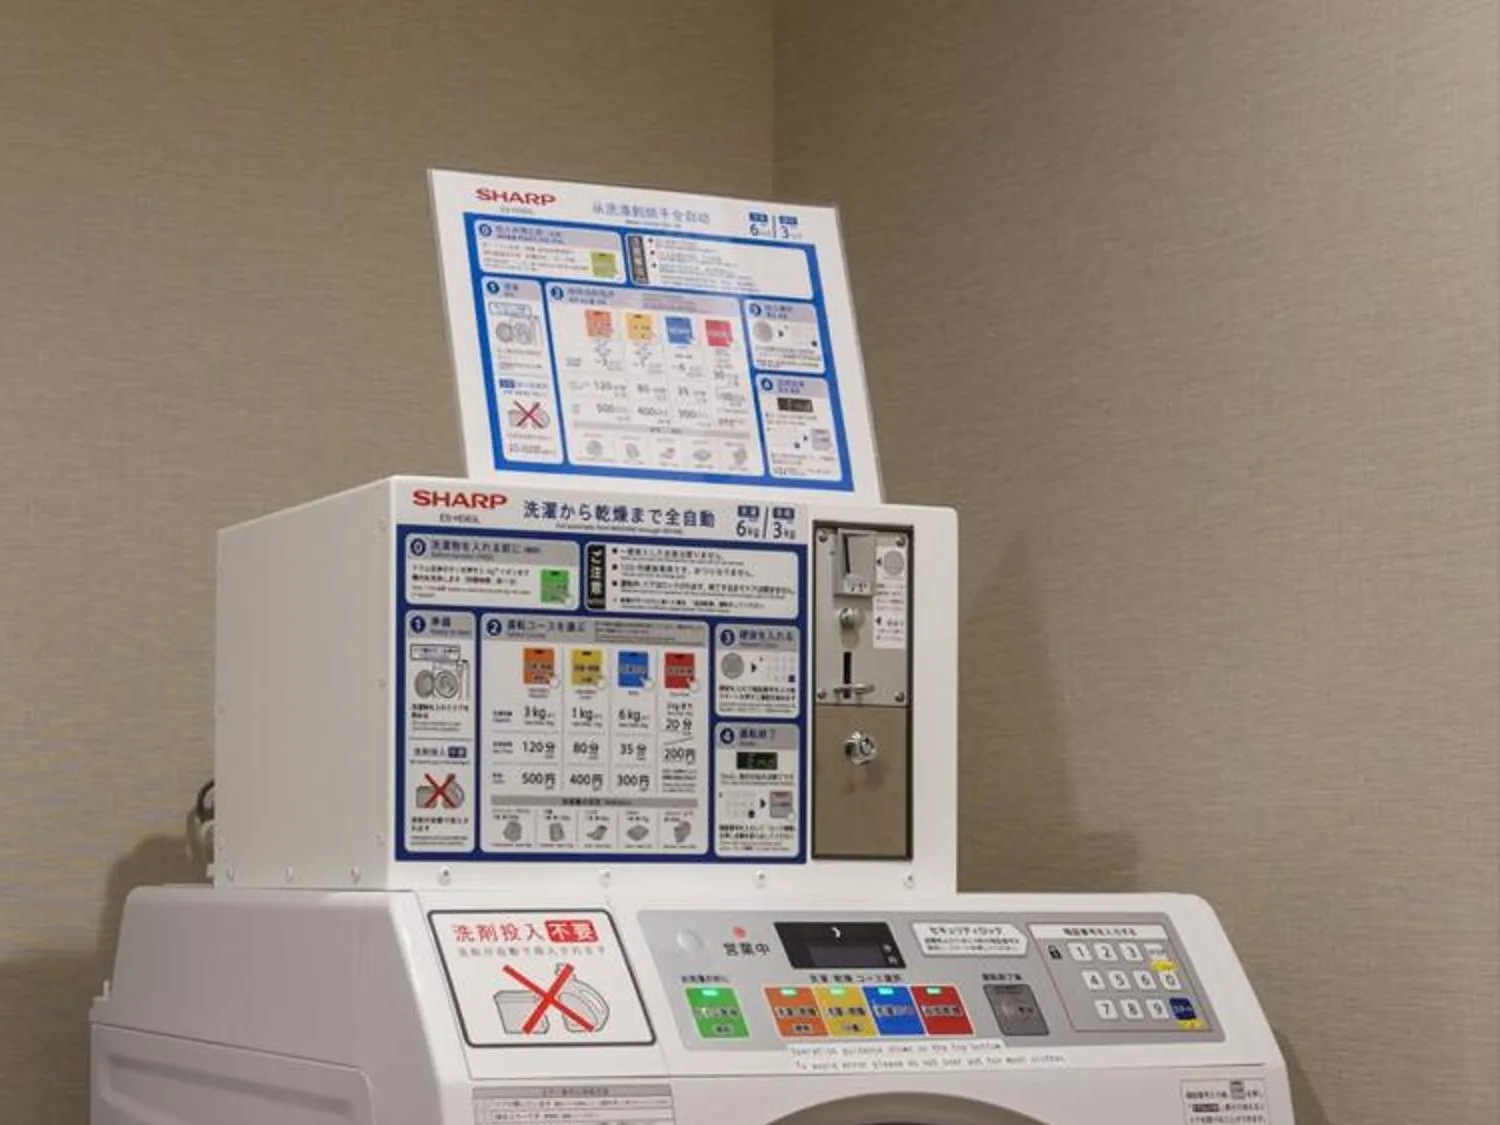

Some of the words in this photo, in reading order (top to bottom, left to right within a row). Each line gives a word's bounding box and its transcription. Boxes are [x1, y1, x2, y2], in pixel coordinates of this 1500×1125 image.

[475, 187, 556, 206] SHARP
[412, 489, 508, 509] SHARP
[523, 500, 716, 528] 洗濯から乾燥まで全自動
[452, 922, 546, 942] 洗剤投入
[1101, 946, 1113, 958] 2
[1128, 946, 1138, 959] 3
[1089, 974, 1100, 987] 4
[1115, 974, 1125, 987] 5
[1141, 974, 1152, 987] 6
[1102, 1002, 1111, 1015] 7
[1128, 1002, 1138, 1015] 8
[1154, 1002, 1164, 1015] 9
